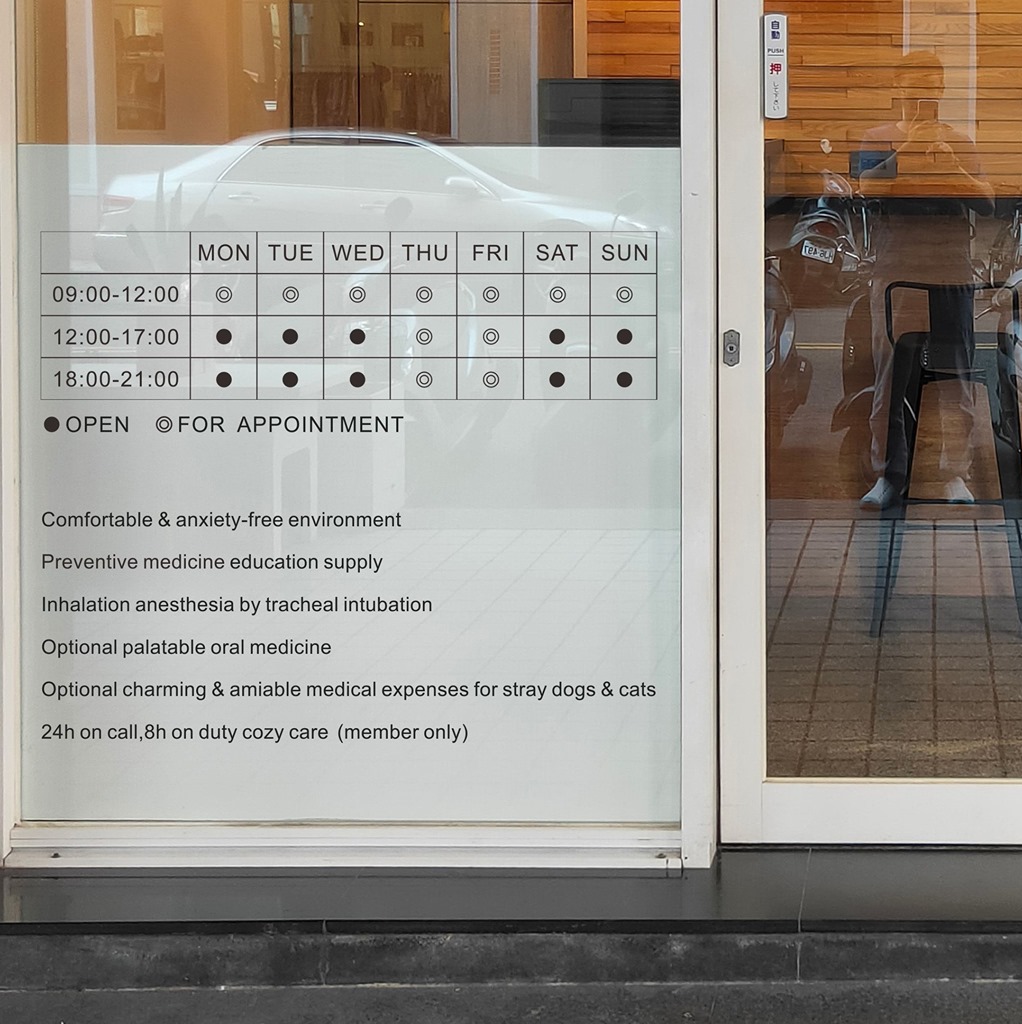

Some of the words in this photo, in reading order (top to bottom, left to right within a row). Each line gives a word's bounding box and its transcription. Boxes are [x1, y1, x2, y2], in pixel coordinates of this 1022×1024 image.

[198, 243, 250, 262] MON
[267, 244, 314, 262] TUE
[331, 244, 385, 262] WED
[401, 243, 448, 262] THU
[472, 244, 508, 262] FRI
[536, 243, 579, 262] SAT
[601, 243, 648, 262] SUN
[52, 285, 179, 303] 09:00-12:00
[53, 328, 179, 346] 12:00-17:00
[53, 370, 179, 388] 18:00-21:00
[65, 415, 129, 433] OPEN
[178, 415, 225, 434] FOR
[236, 415, 405, 433] APPOINTMENT
[41, 510, 153, 528] Comfortable
[157, 511, 171, 528] &
[175, 511, 284, 532] anxiety-free
[288, 511, 402, 528] environment
[41, 553, 139, 570] Preventive
[143, 553, 225, 570] medicine
[229, 553, 319, 570] education
[323, 553, 384, 574] supply
[42, 595, 130, 613] Inhalation
[135, 596, 235, 613] anesthesia
[239, 596, 262, 617] by
[265, 596, 338, 613] tracheal
[343, 596, 433, 613] intubation
[41, 638, 118, 659] Optional
[122, 638, 206, 659] palatable
[210, 638, 245, 655] oral
[250, 638, 332, 655] medicine
[41, 680, 118, 701] Optional
[122, 680, 207, 701] charming
[211, 680, 225, 697] &
[229, 680, 302, 698] amiable
[306, 681, 377, 697] medical
[381, 684, 469, 701] expenses
[473, 680, 499, 697] for
[502, 681, 548, 701] stray
[551, 681, 596, 701] dogs
[600, 680, 614, 697] &
[618, 681, 657, 698] cats
[41, 723, 75, 740] 24h
[79, 727, 102, 740] on
[107, 723, 167, 742] call,8h
[171, 727, 194, 740] on
[198, 723, 238, 744] duty
[242, 727, 285, 744] cozy
[288, 727, 329, 740] care
[337, 723, 420, 744] (member
[423, 723, 469, 744] only)
